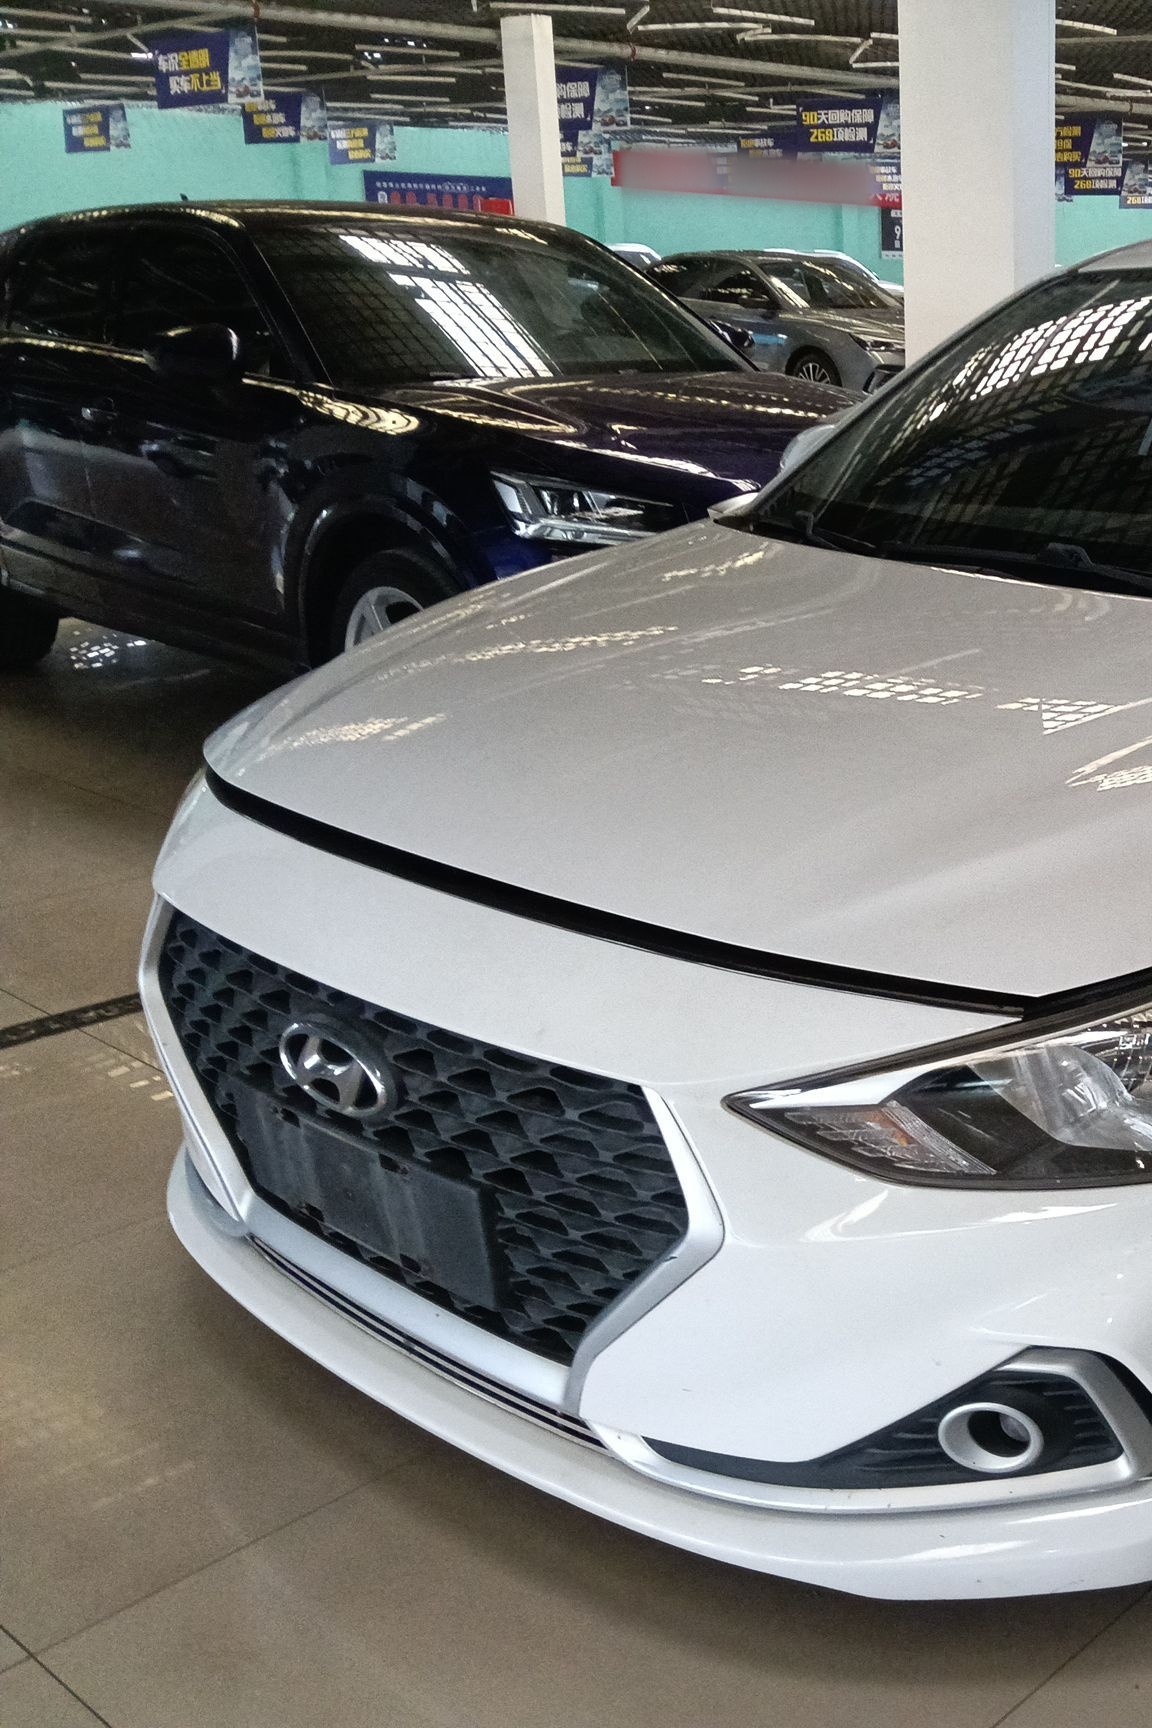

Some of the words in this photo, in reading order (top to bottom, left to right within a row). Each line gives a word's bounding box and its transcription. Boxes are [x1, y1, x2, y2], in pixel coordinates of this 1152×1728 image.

[801, 108, 875, 126] 90天回购保障
